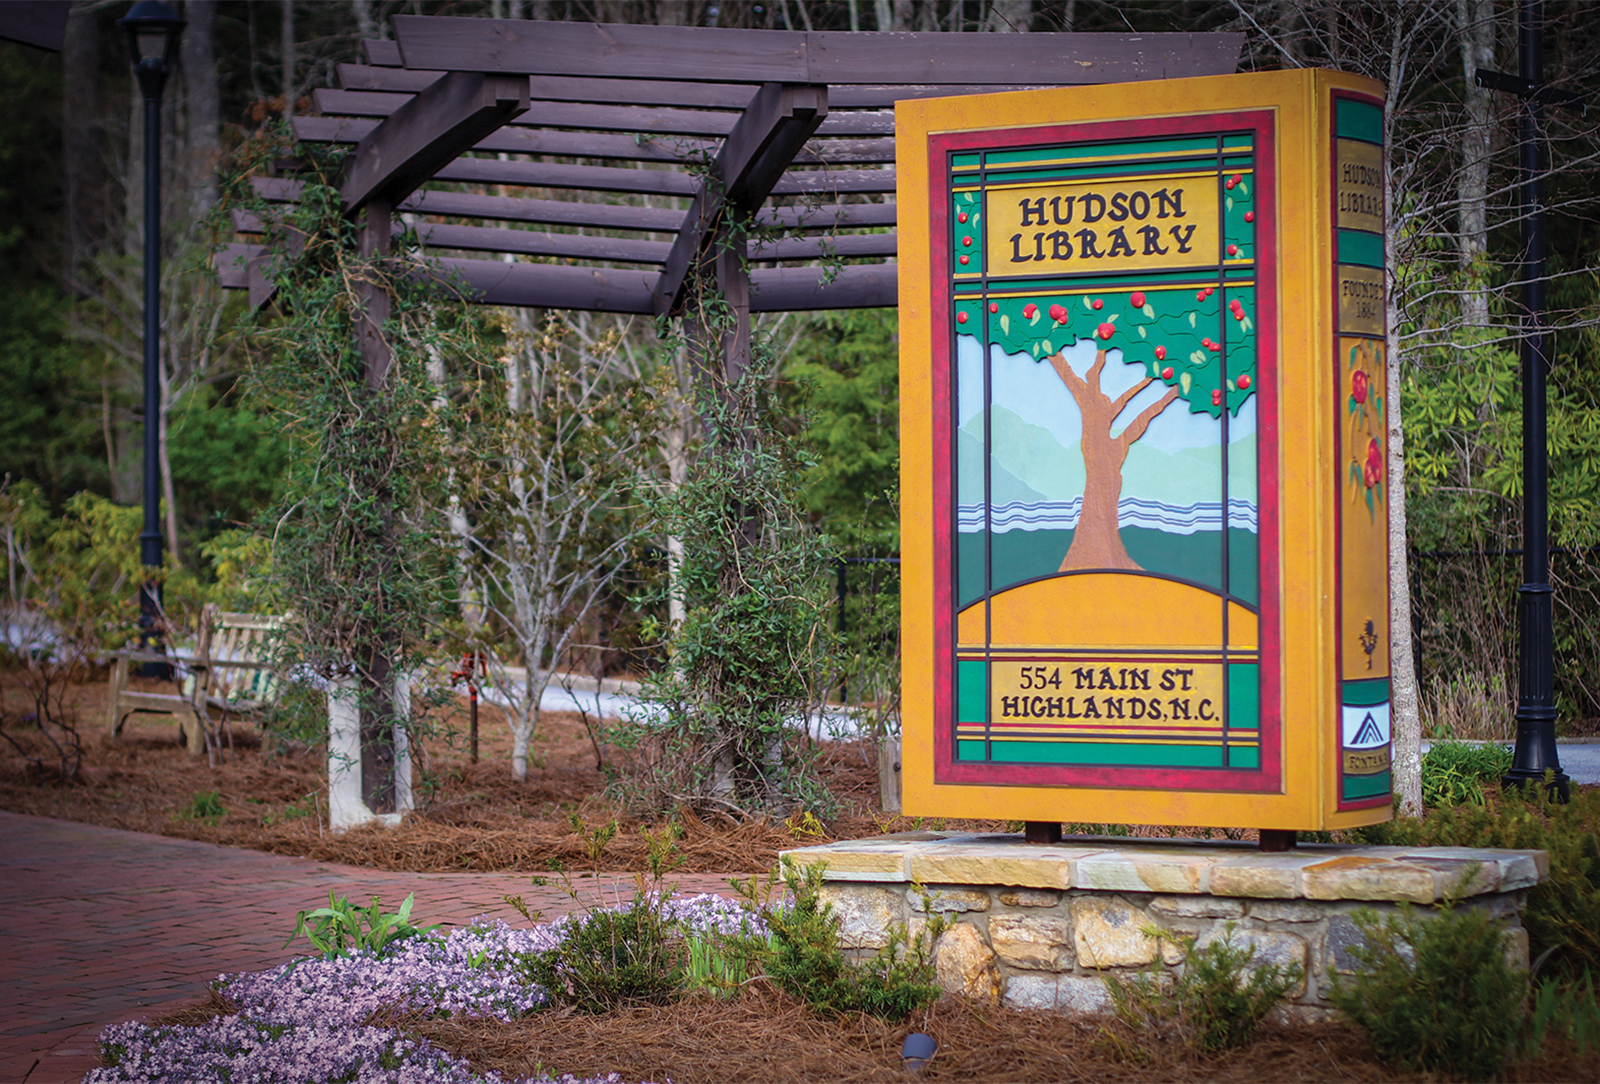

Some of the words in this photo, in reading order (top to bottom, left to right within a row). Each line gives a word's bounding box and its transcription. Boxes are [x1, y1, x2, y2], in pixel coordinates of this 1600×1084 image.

[1018, 188, 1187, 227] HUDSON
[1009, 225, 1197, 263] LIBRARY
[1020, 666, 1062, 690] 554
[1071, 667, 1152, 690] MAIN
